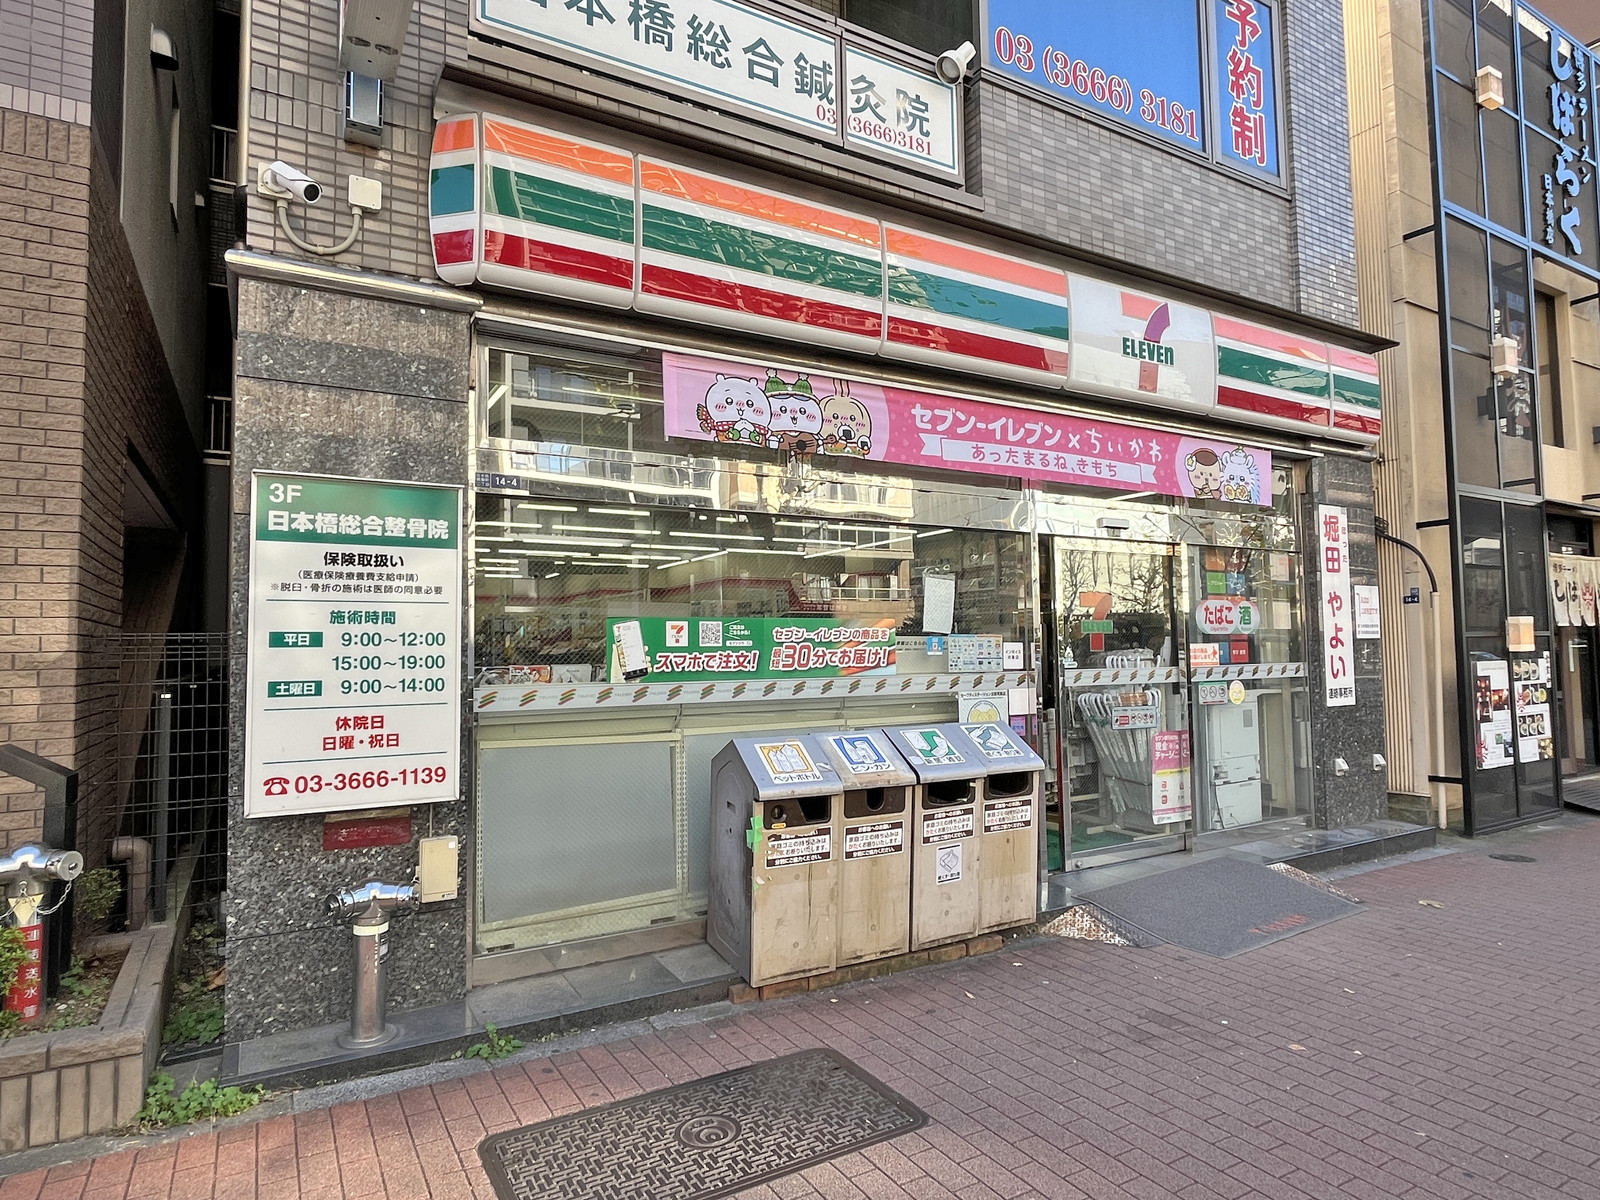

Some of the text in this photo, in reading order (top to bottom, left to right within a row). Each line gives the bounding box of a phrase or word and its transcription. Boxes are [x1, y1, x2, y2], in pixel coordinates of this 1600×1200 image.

[520, 0, 931, 138] 本橋総合鍼灸院
[994, 27, 1199, 141] 03 (3666) 3181
[1226, 0, 1267, 166] 予約制
[816, 104, 837, 124] 03
[496, 477, 518, 487] 14-4
[268, 483, 303, 503] 3F
[267, 510, 449, 540] 日本橋総合整骨院
[1323, 514, 1341, 573] 堀田
[323, 552, 404, 569] 保険取扱い
[329, 610, 396, 626] 施術時間
[1204, 605, 1252, 625] たばこ 酒
[283, 633, 310, 647] 平日
[1327, 591, 1347, 680] やよい
[655, 651, 760, 671] スマホで注文!
[275, 682, 316, 697] 土曜日
[335, 715, 385, 731] 休院日
[322, 733, 400, 751] 日曜・祝日
[294, 766, 447, 794] 03-3666-1139
